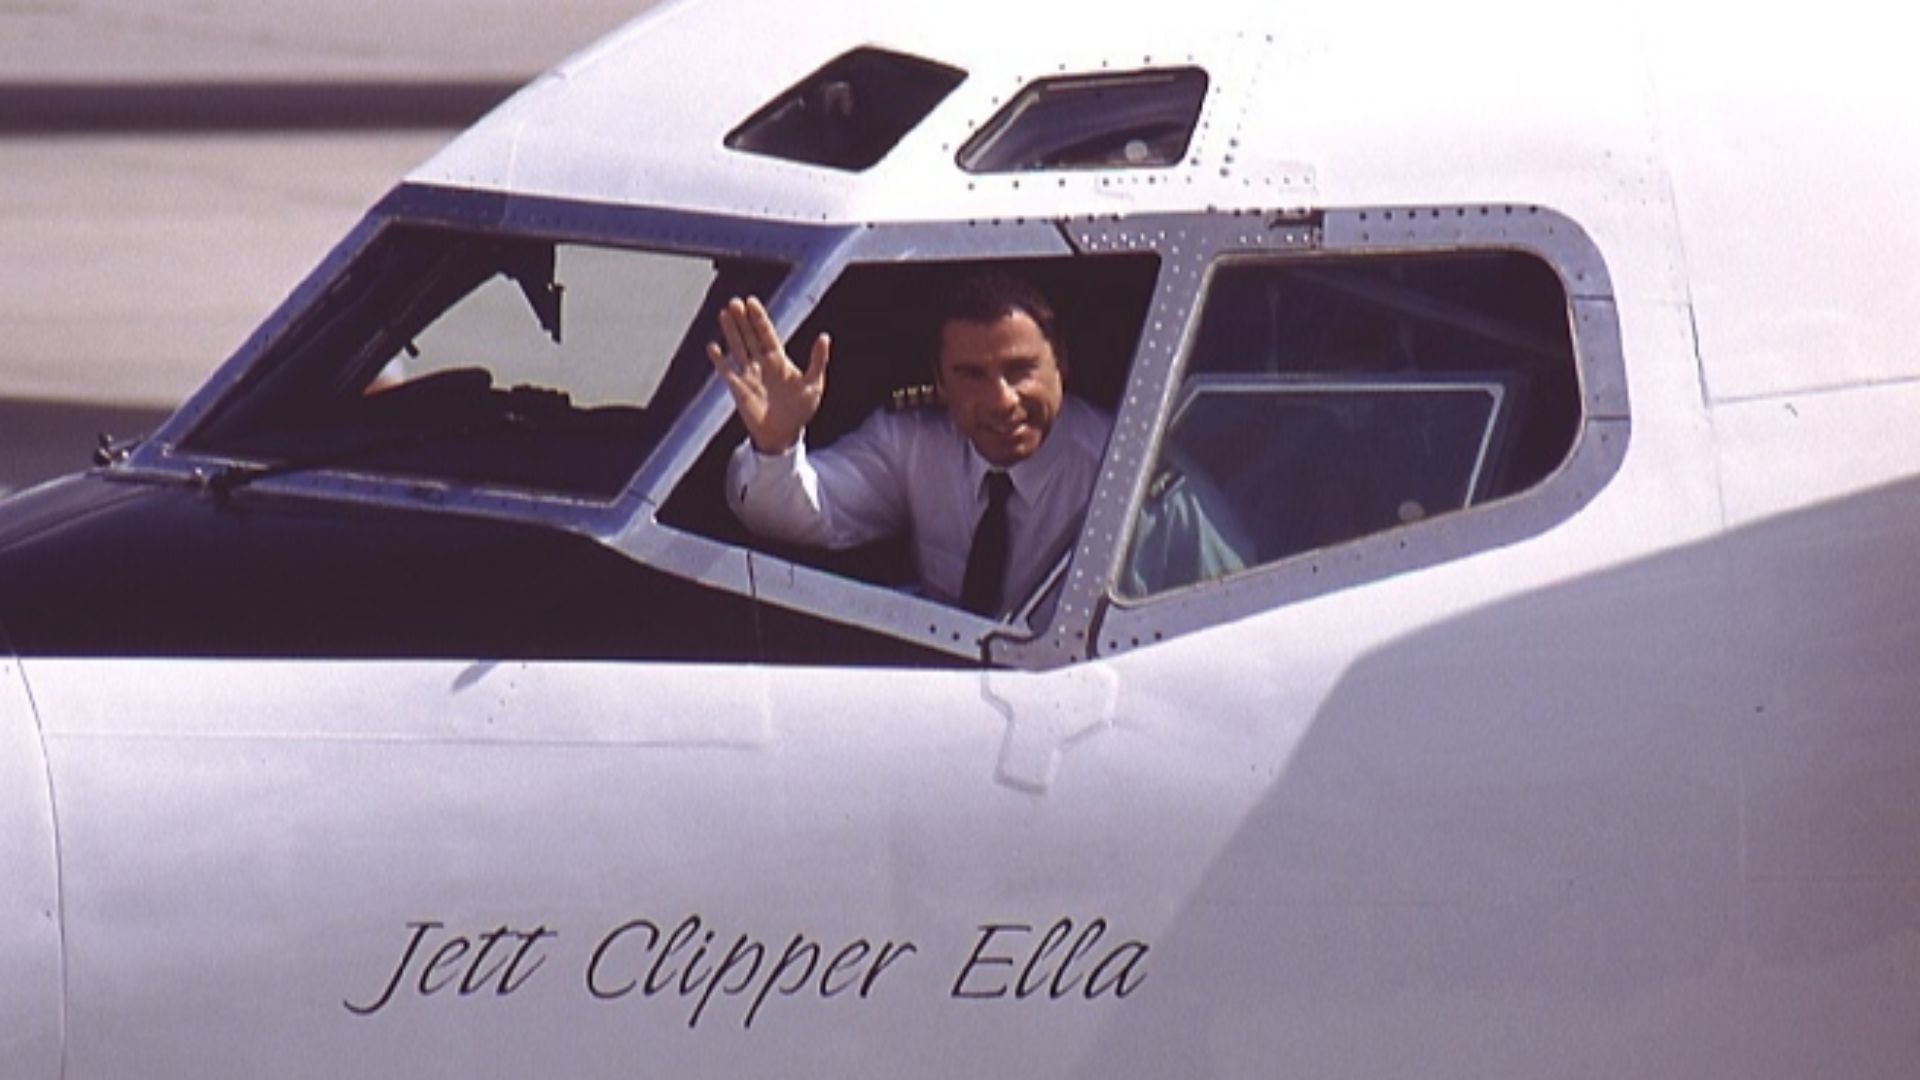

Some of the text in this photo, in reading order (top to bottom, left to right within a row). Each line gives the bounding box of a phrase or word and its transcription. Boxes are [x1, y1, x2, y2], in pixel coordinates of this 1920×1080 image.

[343, 914, 1150, 1029] Jett Clipper Ella
